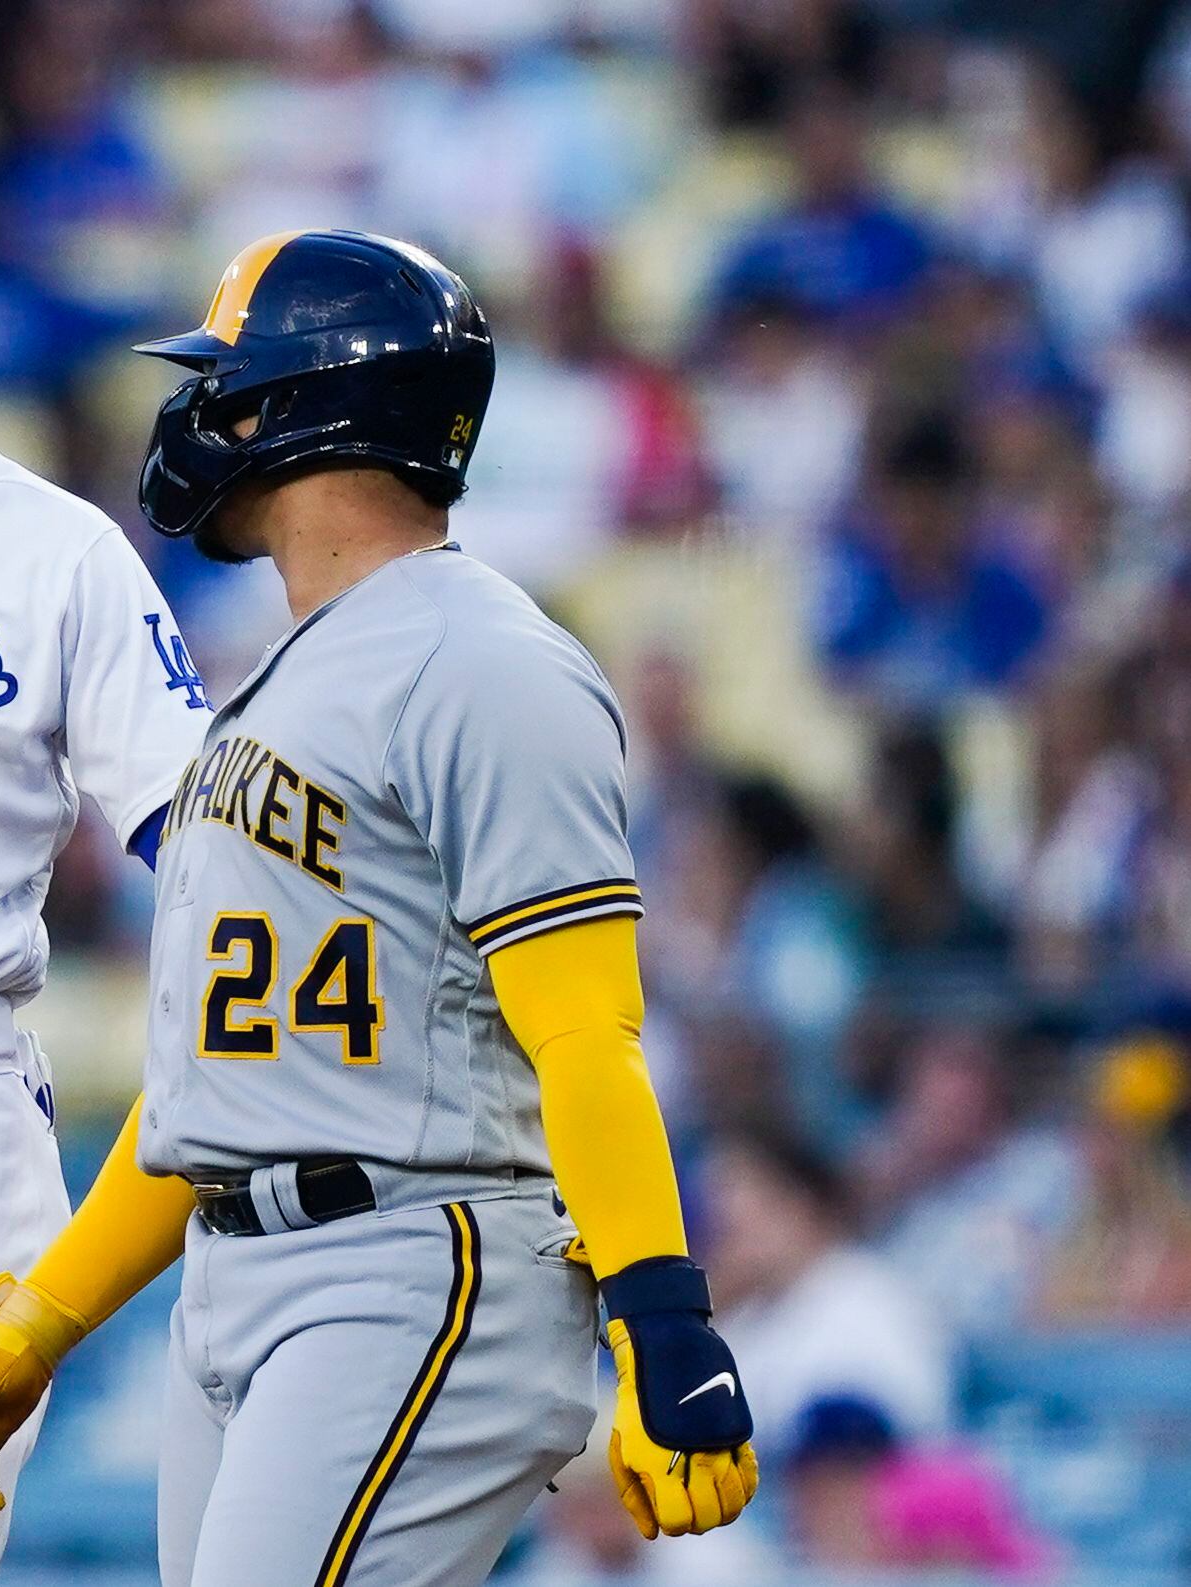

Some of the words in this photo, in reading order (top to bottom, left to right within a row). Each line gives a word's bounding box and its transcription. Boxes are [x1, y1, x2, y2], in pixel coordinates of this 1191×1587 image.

[450, 414, 474, 445] 24
[157, 735, 347, 895] WAUKEE
[196, 910, 386, 1066] 24
